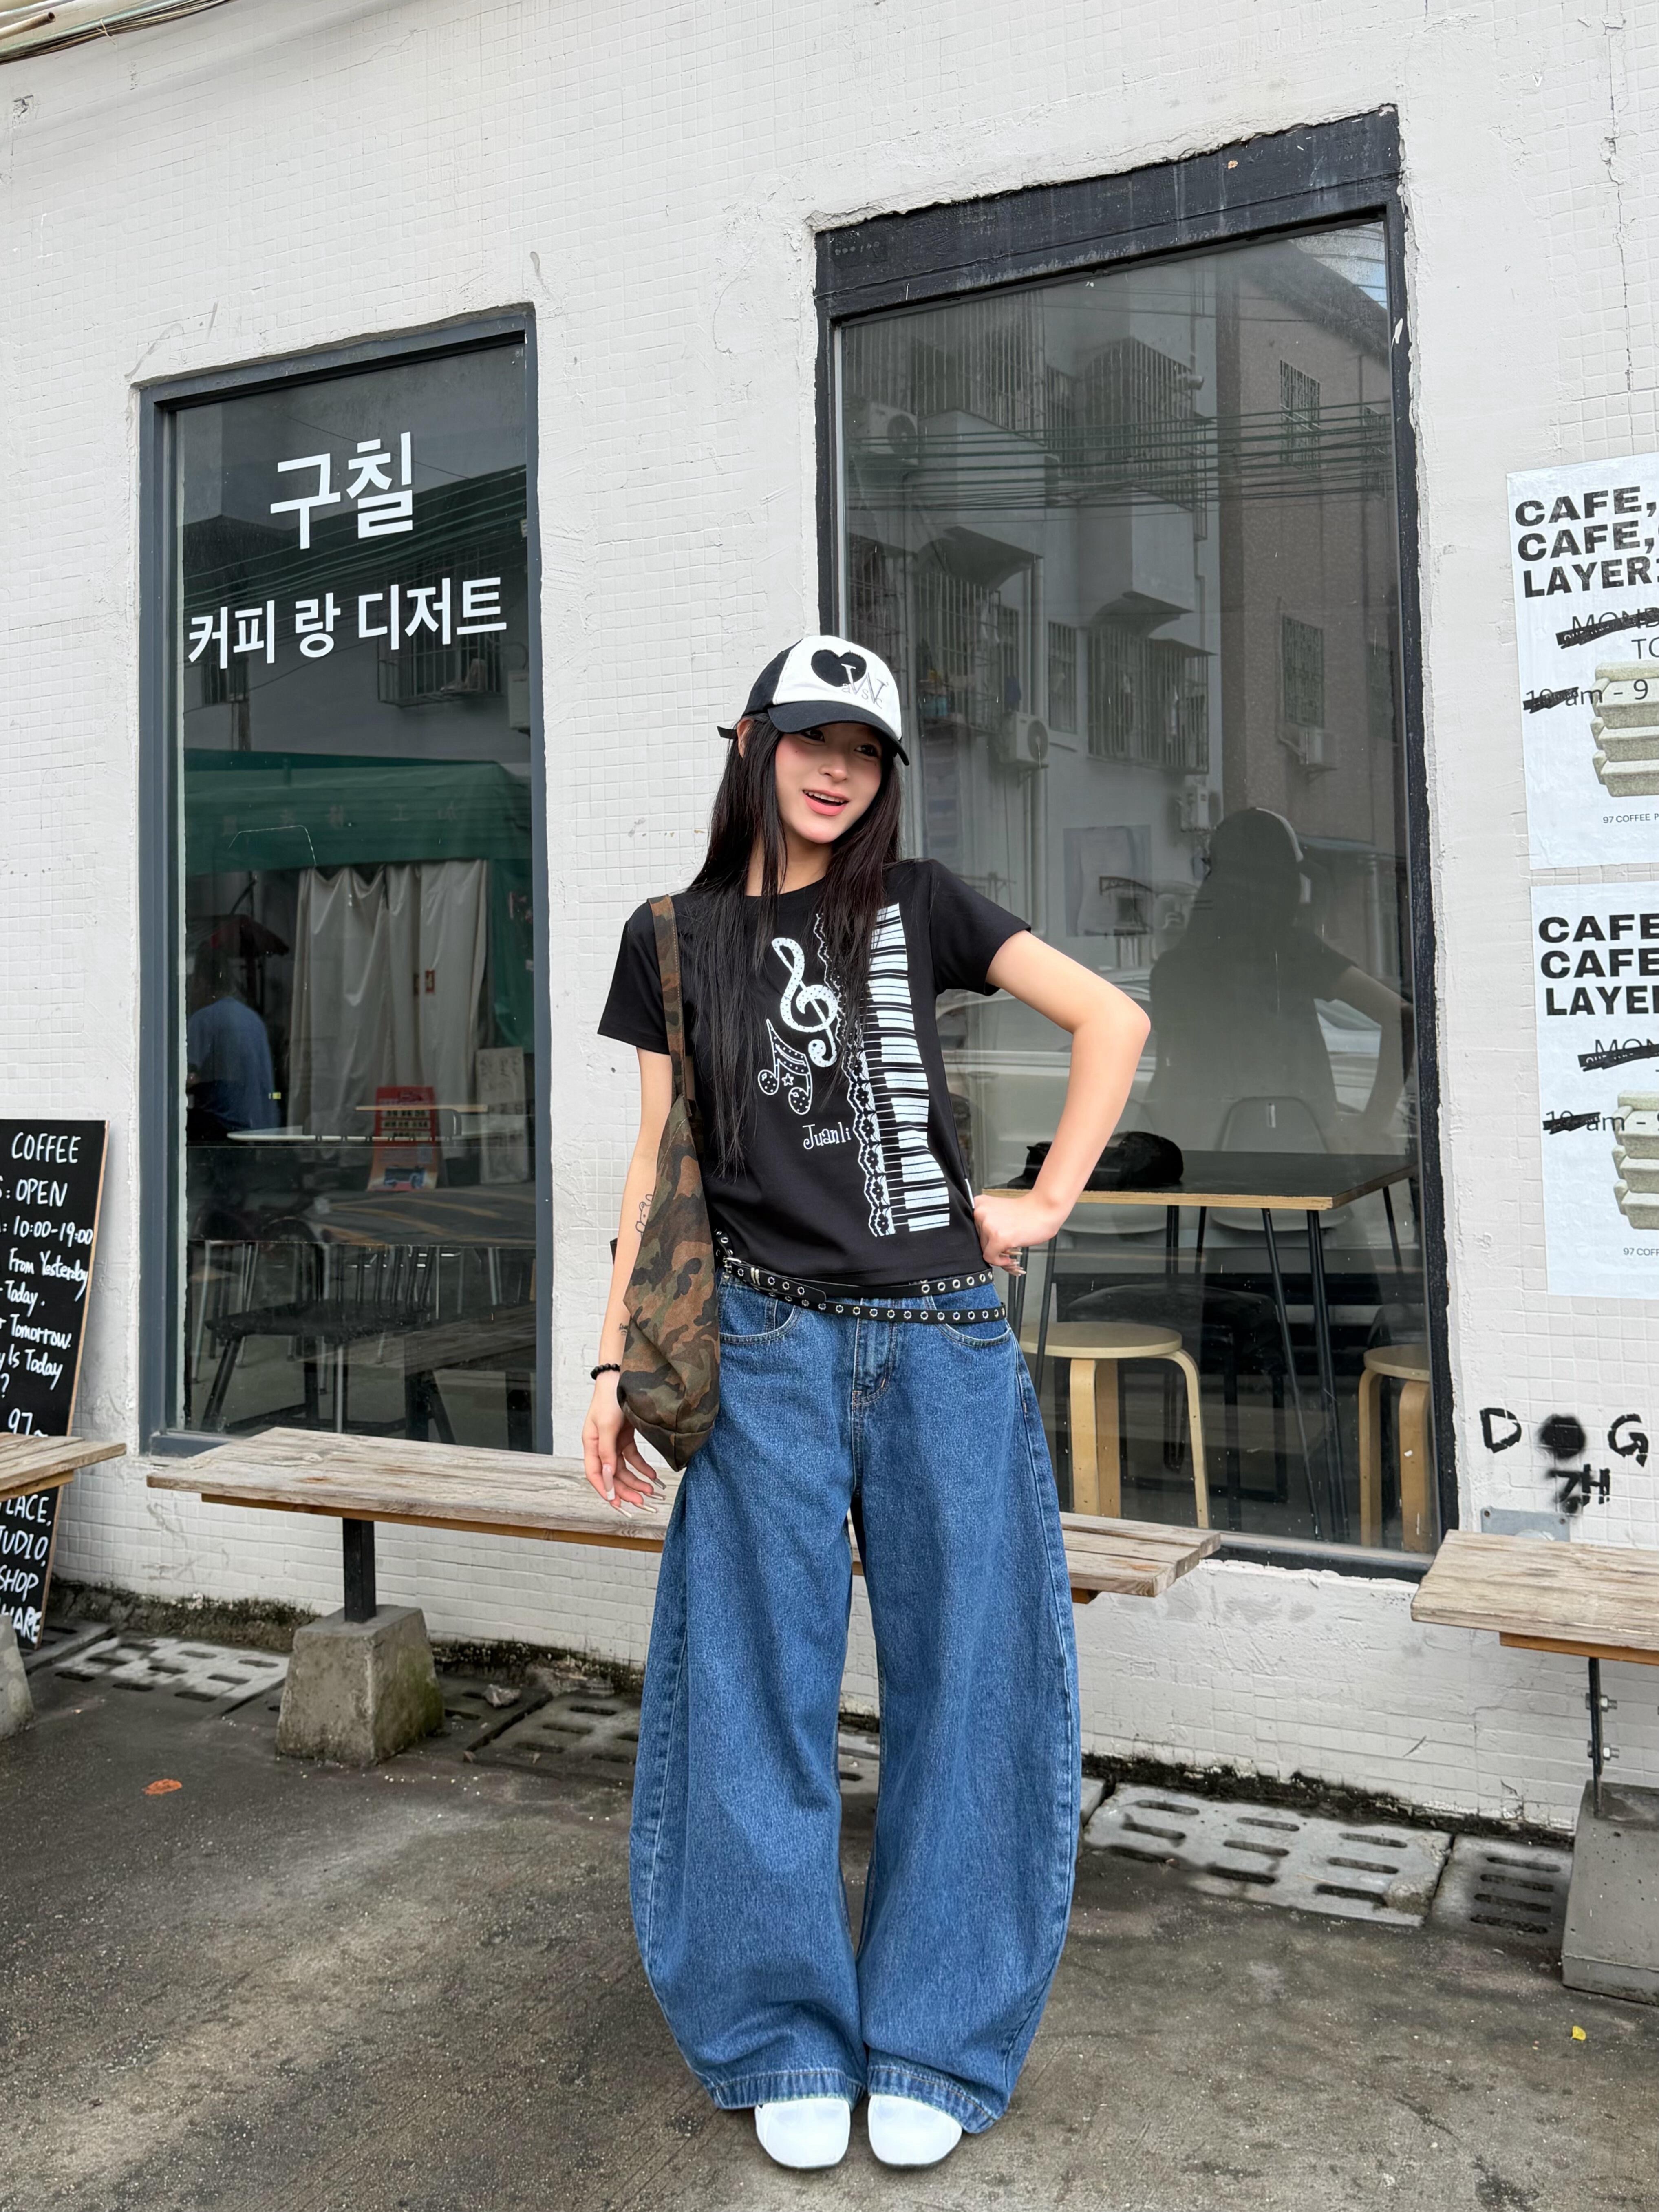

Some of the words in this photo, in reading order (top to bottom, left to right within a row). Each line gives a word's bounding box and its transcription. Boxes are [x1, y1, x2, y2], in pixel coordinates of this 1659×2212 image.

[270, 431, 413, 550] 구칠
[1515, 486, 1657, 527] CAFE,
[1523, 556, 1659, 598] LAYER
[188, 600, 275, 669] 커피
[295, 592, 341, 658] 랑
[358, 577, 507, 651] 디저트
[1633, 678, 1648, 700] 9
[1602, 816, 1614, 824] 97
[1616, 813, 1651, 823] COFFEE
[1538, 913, 1659, 943] CAFE
[1540, 947, 1659, 979] CAFE
[1546, 985, 1659, 1016] LAYE
[11, 1132, 82, 1164] COFFEE
[802, 1121, 852, 1150] Juanli
[15, 1177, 68, 1207] OPEN
[13, 1215, 94, 1247] 10:00-19:00
[9, 1247, 35, 1275] From
[1623, 1247, 1635, 1256] 97
[8, 1343, 20, 1369] Is
[24, 1349, 63, 1391] Today
[0, 1494, 52, 1527] LACE,
